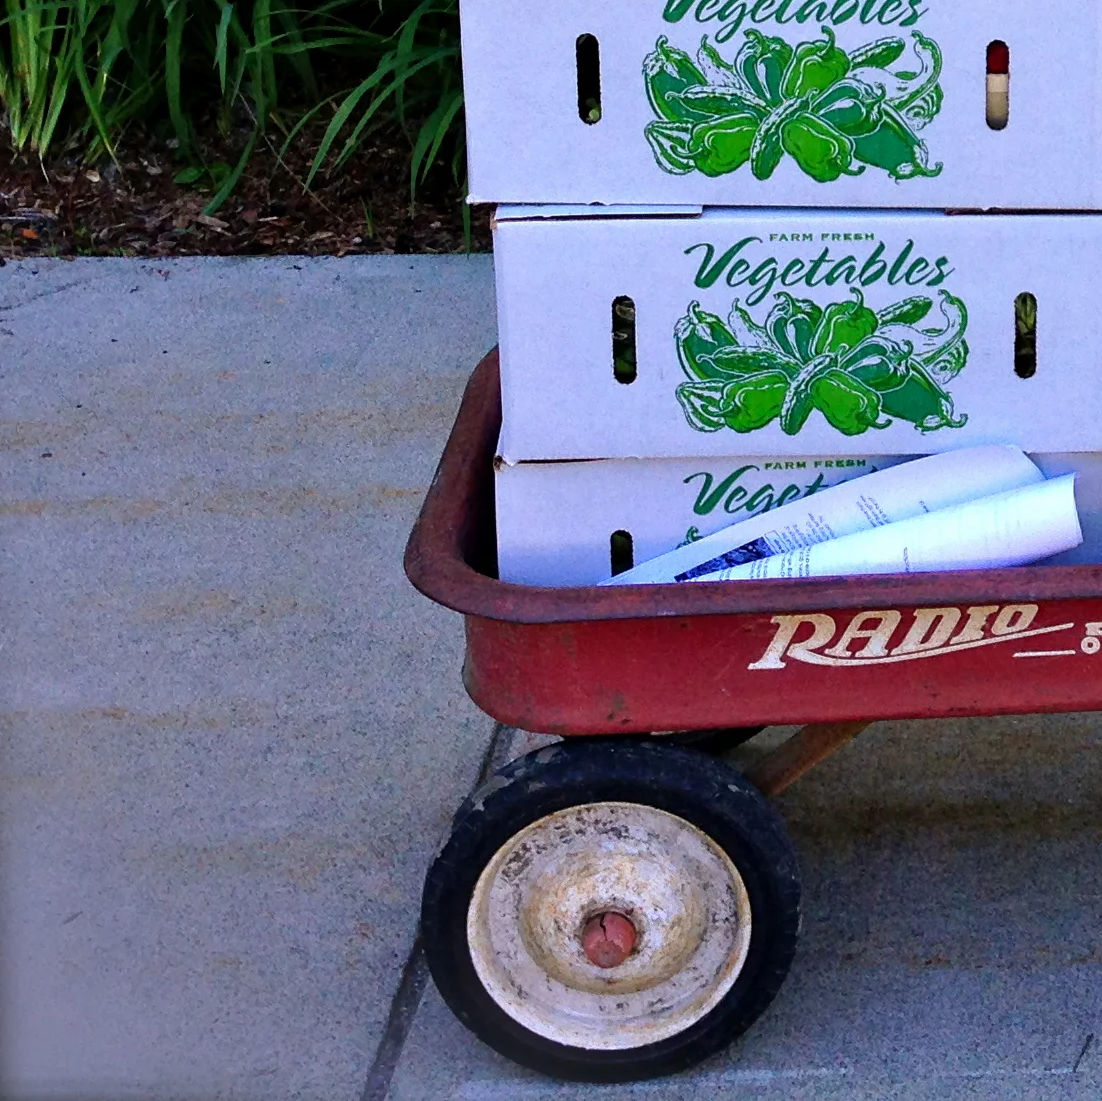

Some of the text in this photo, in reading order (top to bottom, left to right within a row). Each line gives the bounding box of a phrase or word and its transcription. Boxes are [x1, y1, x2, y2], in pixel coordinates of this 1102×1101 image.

[769, 232, 875, 242] FARM FRESH
[684, 236, 955, 306] Vegetables
[764, 459, 866, 470] FARM FRESH
[683, 465, 878, 518] Veget
[747, 604, 1039, 670] RADIO
